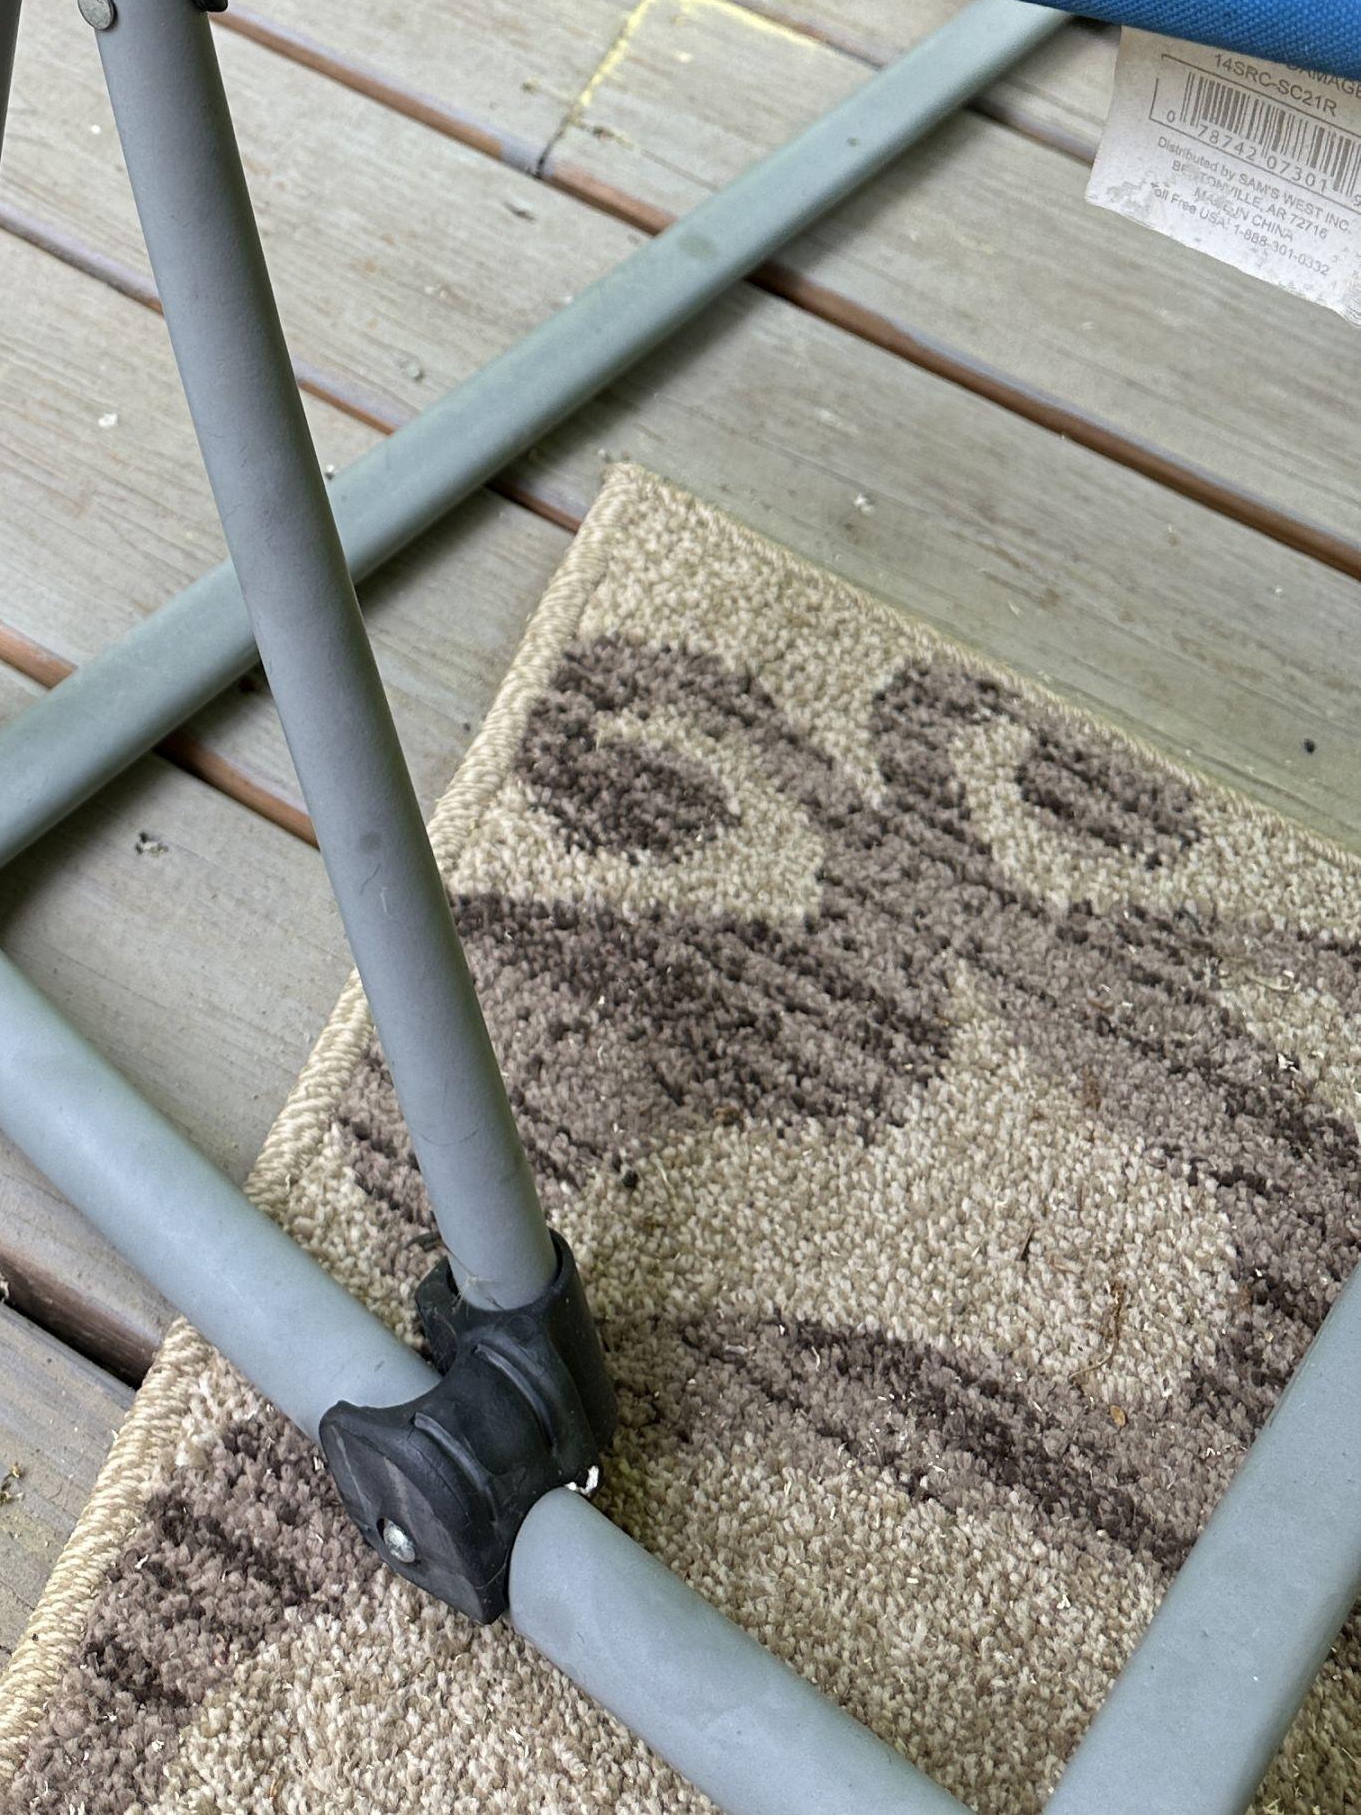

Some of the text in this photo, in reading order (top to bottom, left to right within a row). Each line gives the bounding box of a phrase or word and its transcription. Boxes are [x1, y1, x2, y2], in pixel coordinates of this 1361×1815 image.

[1214, 53, 1337, 117] 14SRC-SC21R
[1197, 124, 1257, 162] 78742
[1266, 155, 1328, 192] 07301
[1157, 135, 1352, 235] Distributed by SAM'S WEST INC.
[1170, 192, 1197, 215] Free
[1251, 215, 1293, 242] CHINA
[1265, 204, 1288, 221] AR
[1289, 212, 1328, 240] 72716
